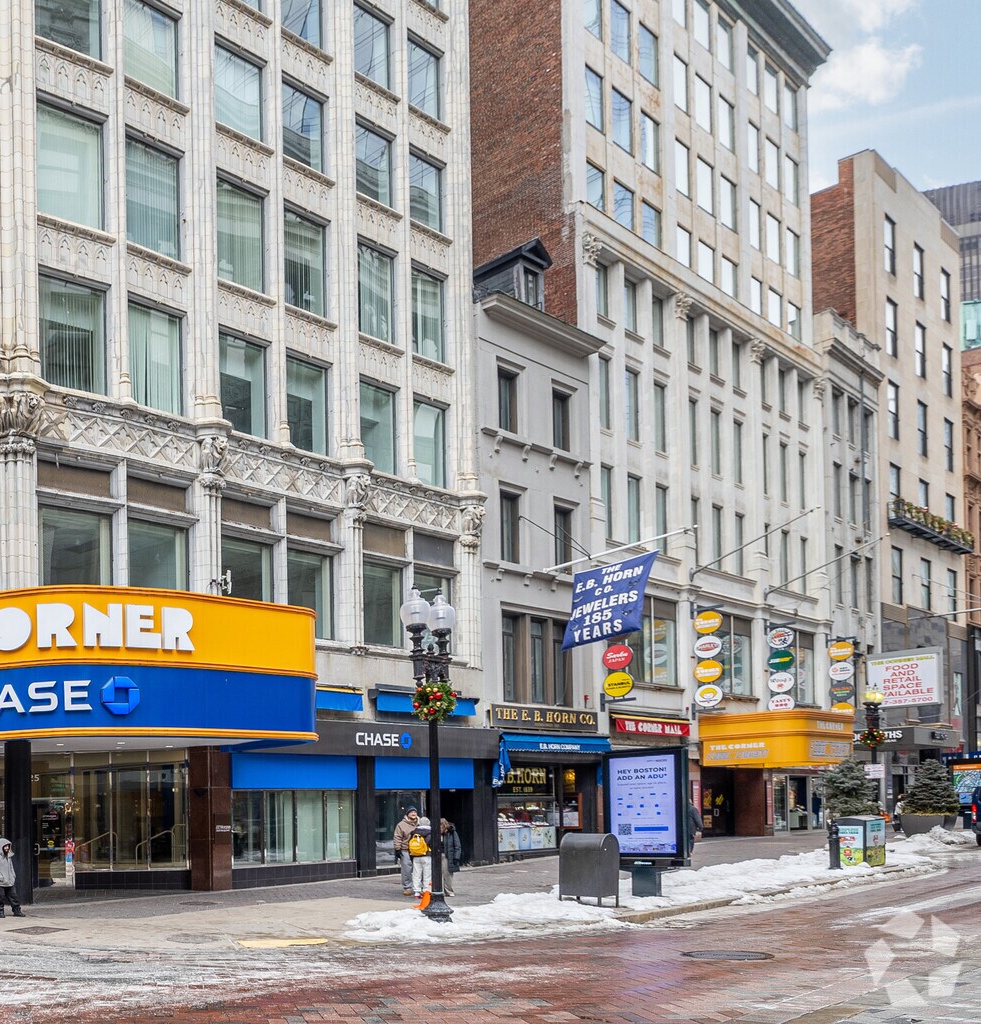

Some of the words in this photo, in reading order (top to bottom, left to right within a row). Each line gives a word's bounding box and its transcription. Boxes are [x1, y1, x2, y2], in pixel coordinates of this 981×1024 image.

[601, 564, 623, 574] THE
[575, 579, 598, 593] E.B.
[602, 566, 644, 584] HORN
[570, 590, 638, 620] JEWELERS
[583, 609, 612, 626] 185
[574, 619, 622, 643] YEARS
[885, 663, 919, 671] FOOD
[883, 676, 922, 684] RETAIL
[883, 682, 922, 691] SPACE
[882, 687, 934, 697] VAILABLE
[496, 708, 518, 720] THE
[521, 710, 531, 721] E.
[534, 710, 544, 722] B.
[546, 712, 577, 724] HORN
[579, 714, 596, 725] CO.
[664, 724, 683, 735] MALL
[355, 732, 400, 747] CHASE
[517, 767, 547, 784] HORN
